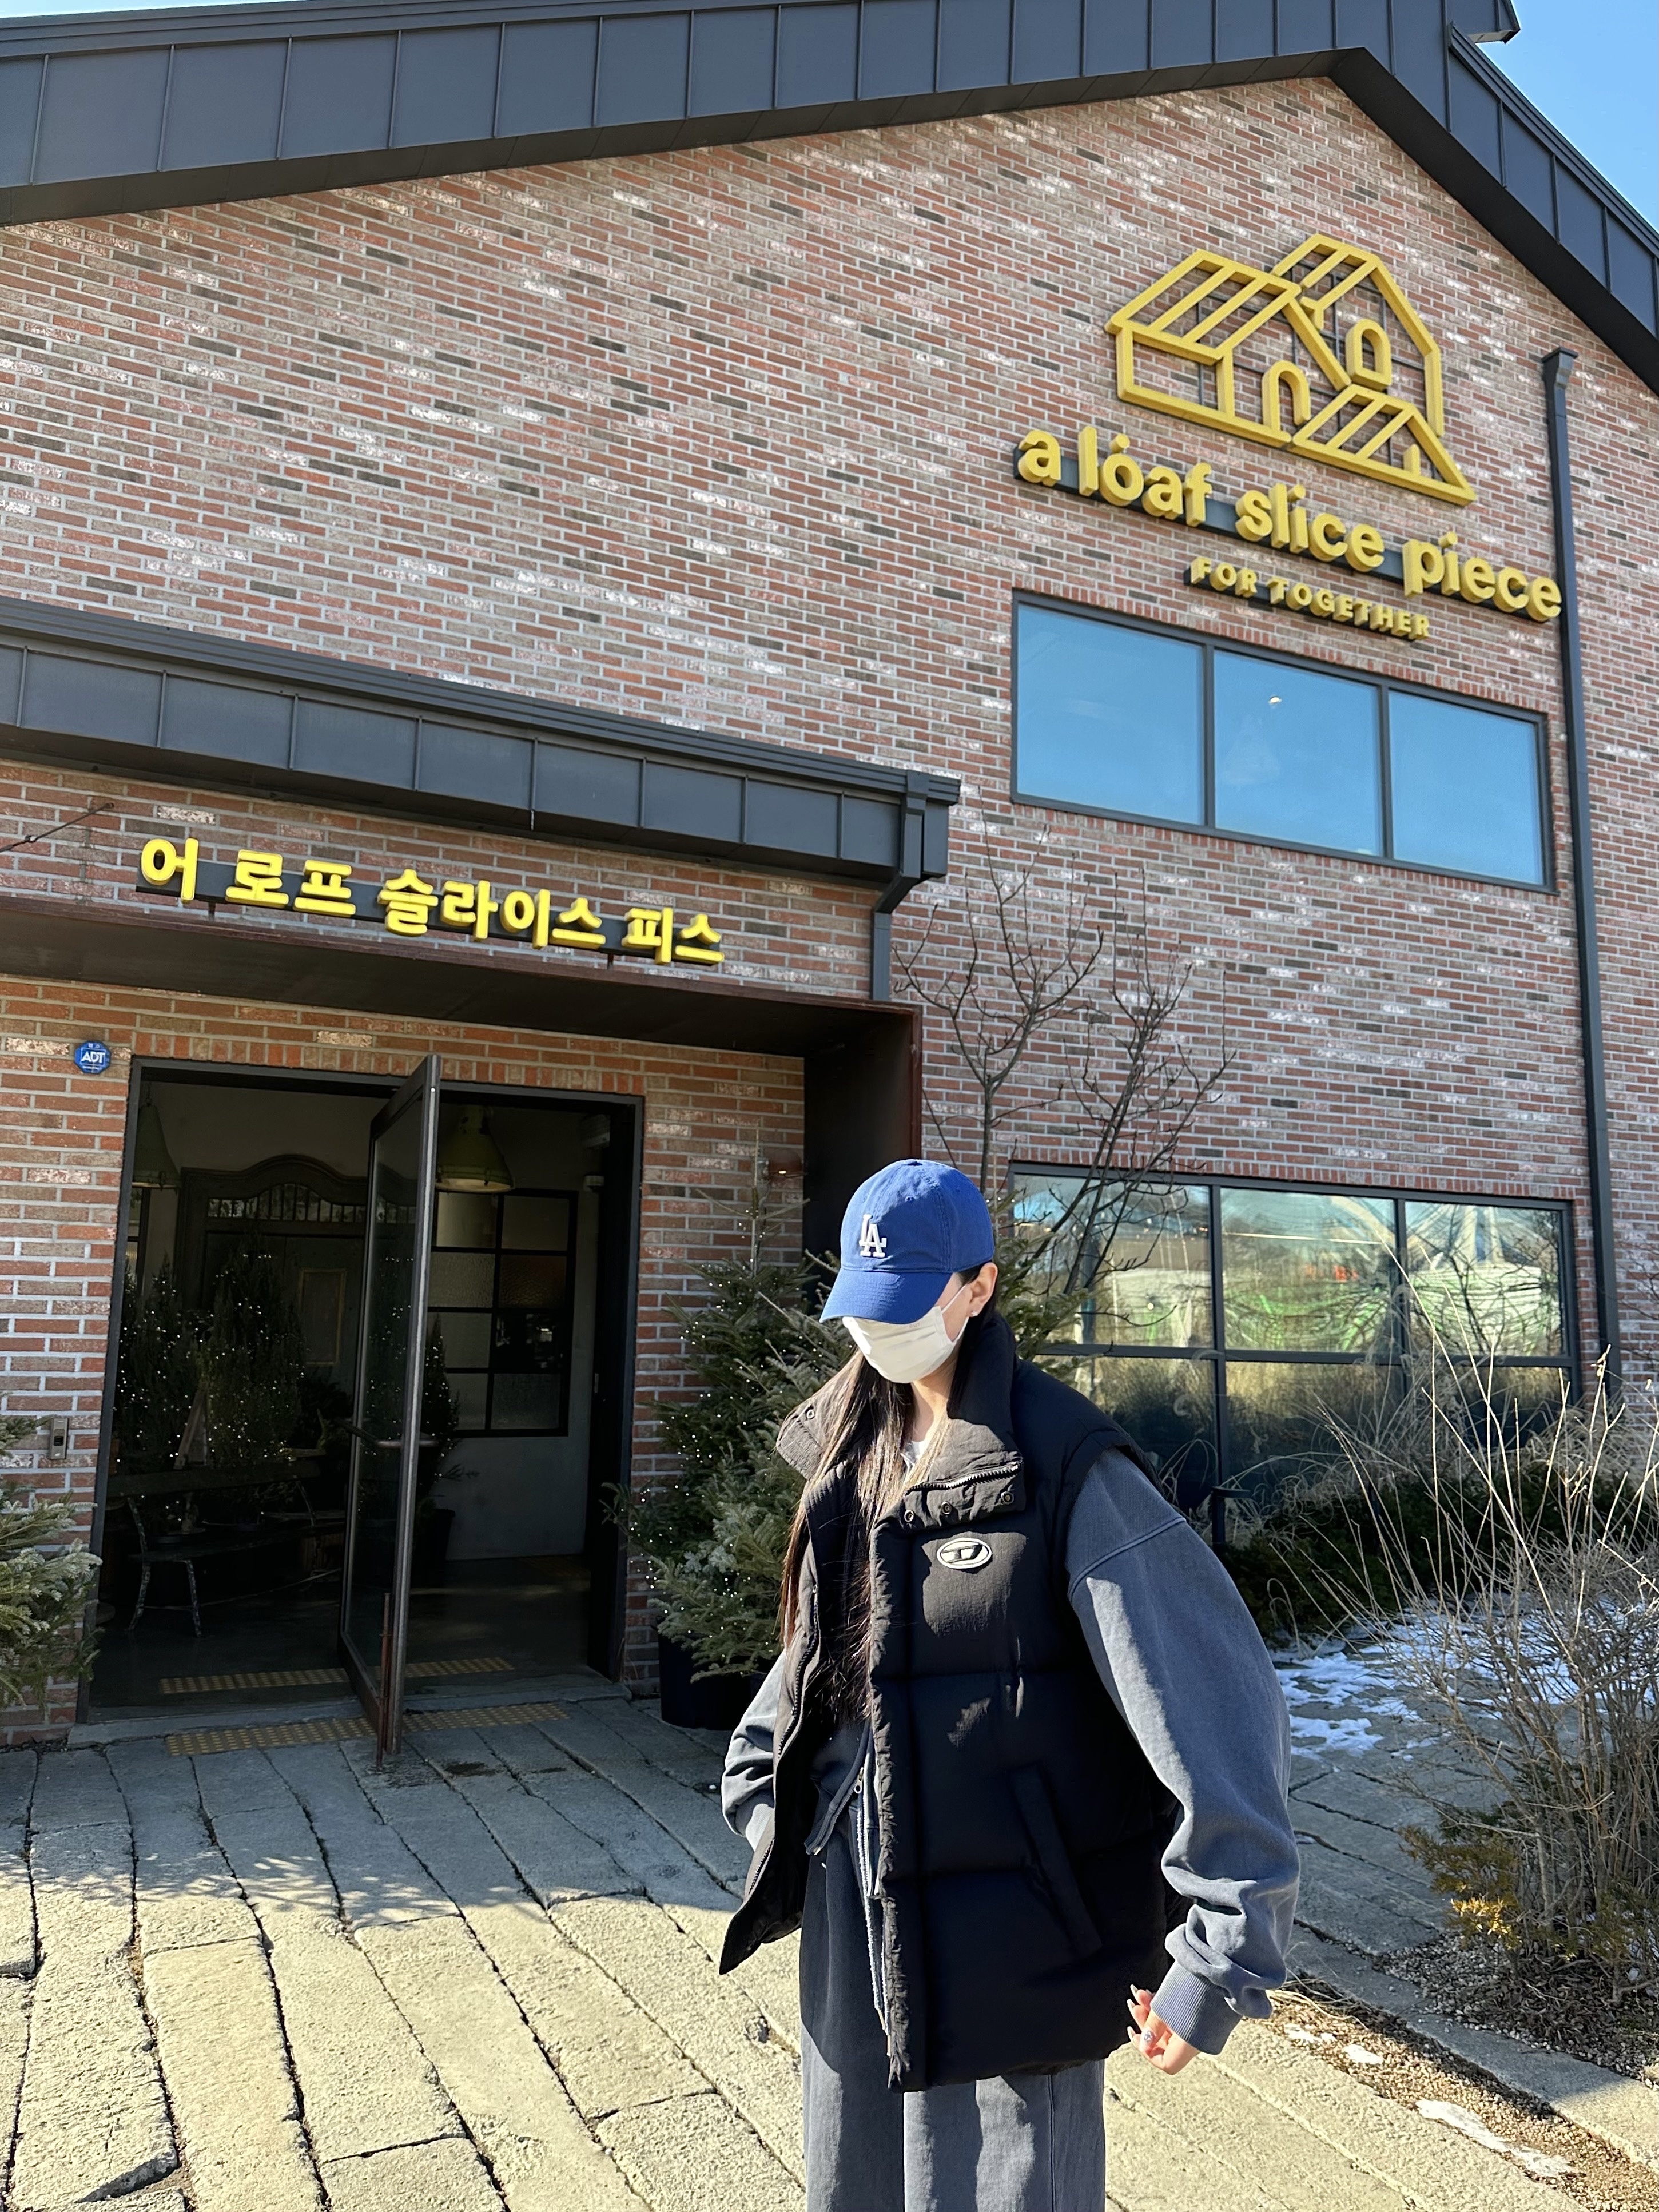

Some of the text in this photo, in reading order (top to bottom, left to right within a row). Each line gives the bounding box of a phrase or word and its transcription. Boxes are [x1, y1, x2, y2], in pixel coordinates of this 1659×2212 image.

[1018, 429, 1061, 487] a
[1235, 482, 1385, 572] slice
[1402, 531, 1562, 622] piece
[1191, 556, 1430, 640] FOR TOGETHER
[141, 837, 725, 965] 어 로프 슬라이스 피스
[81, 1051, 106, 1063] ADT
[859, 1214, 887, 1258] LA
